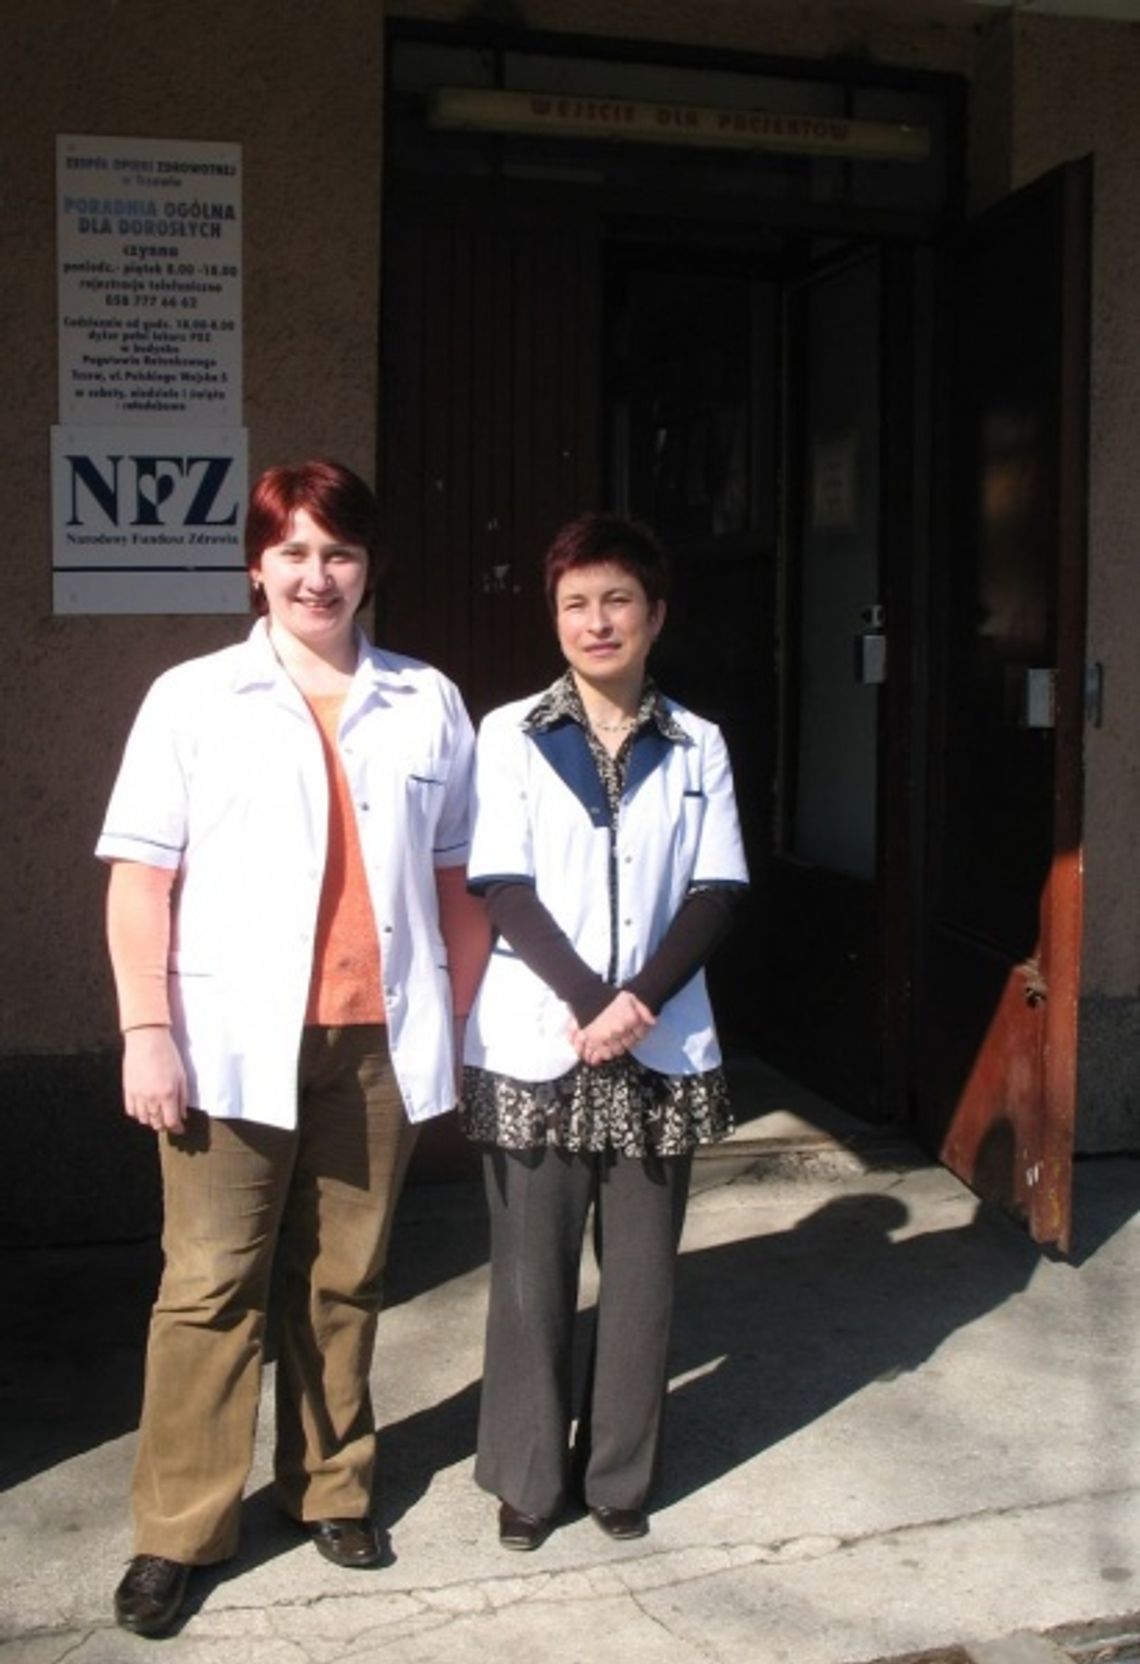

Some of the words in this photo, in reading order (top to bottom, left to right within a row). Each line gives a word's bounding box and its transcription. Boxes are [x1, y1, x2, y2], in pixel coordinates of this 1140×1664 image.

[656, 109, 698, 128] DLA
[113, 158, 153, 172] OPIEKI
[157, 160, 236, 177] ZDROWOTNEJ
[64, 197, 157, 217] PORADNIA
[164, 198, 236, 220] OGÓLNA
[78, 217, 112, 235] DLA
[119, 219, 221, 239] DOROSŁYCH
[122, 246, 178, 260] czynna
[124, 261, 162, 276] piątek
[80, 279, 145, 292] rejestracja
[149, 279, 223, 293] telefoniczna
[105, 294, 129, 306] 058
[133, 295, 157, 306] 777
[64, 316, 122, 328] Codziennie
[126, 317, 139, 328] od
[133, 344, 179, 355] budynku
[83, 355, 140, 367] Pogotowia
[144, 356, 217, 369] Ratunkowego
[124, 371, 176, 383] Polskiego
[180, 372, 217, 383] Wojska
[63, 455, 239, 526] NFZ
[66, 533, 127, 546] Narodowy
[131, 533, 184, 545] Fundusz
[187, 533, 239, 545] Zdrowia
